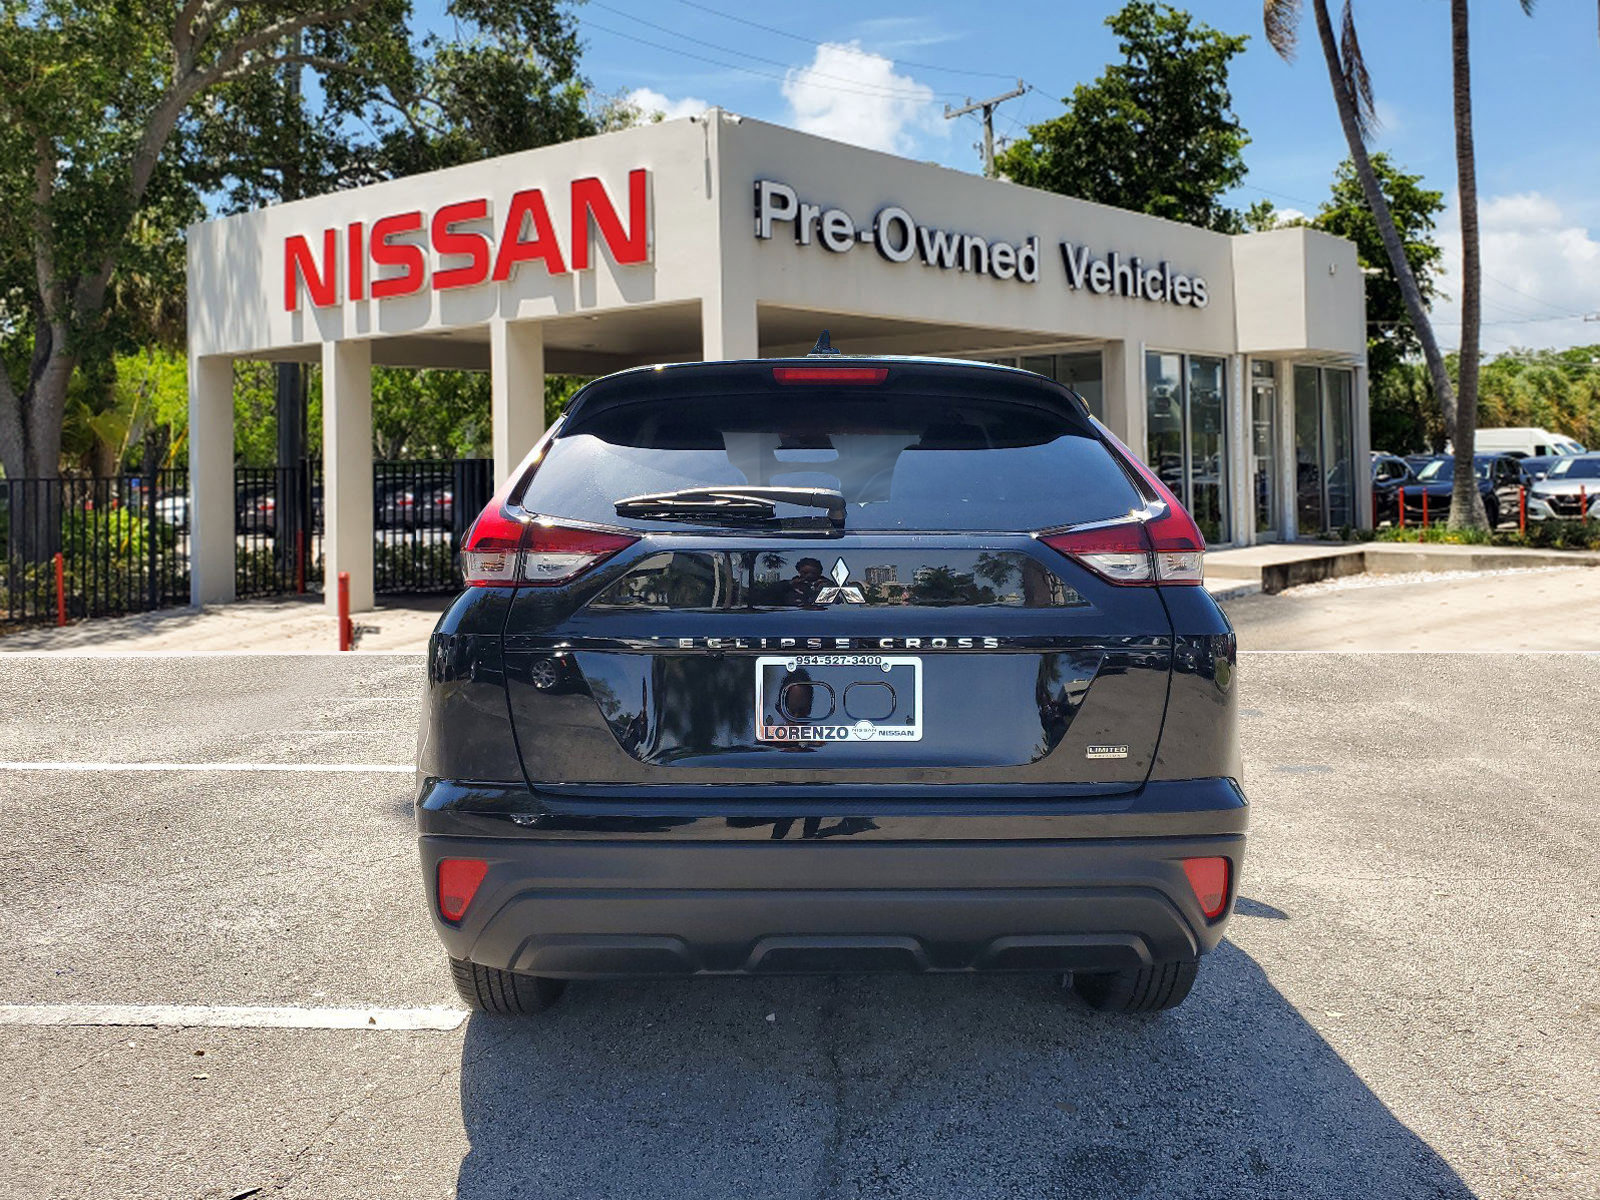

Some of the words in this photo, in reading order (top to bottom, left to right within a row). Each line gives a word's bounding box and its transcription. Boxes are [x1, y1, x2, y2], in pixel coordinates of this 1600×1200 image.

[284, 168, 648, 312] NISSAN
[753, 179, 1041, 284] Pre-Owned
[1059, 241, 1209, 308] Vehicles
[679, 637, 851, 650] ECLIPSE
[879, 637, 1000, 650] CROSS
[796, 656, 883, 665] 954-527-3400
[764, 726, 849, 740] LORENZO
